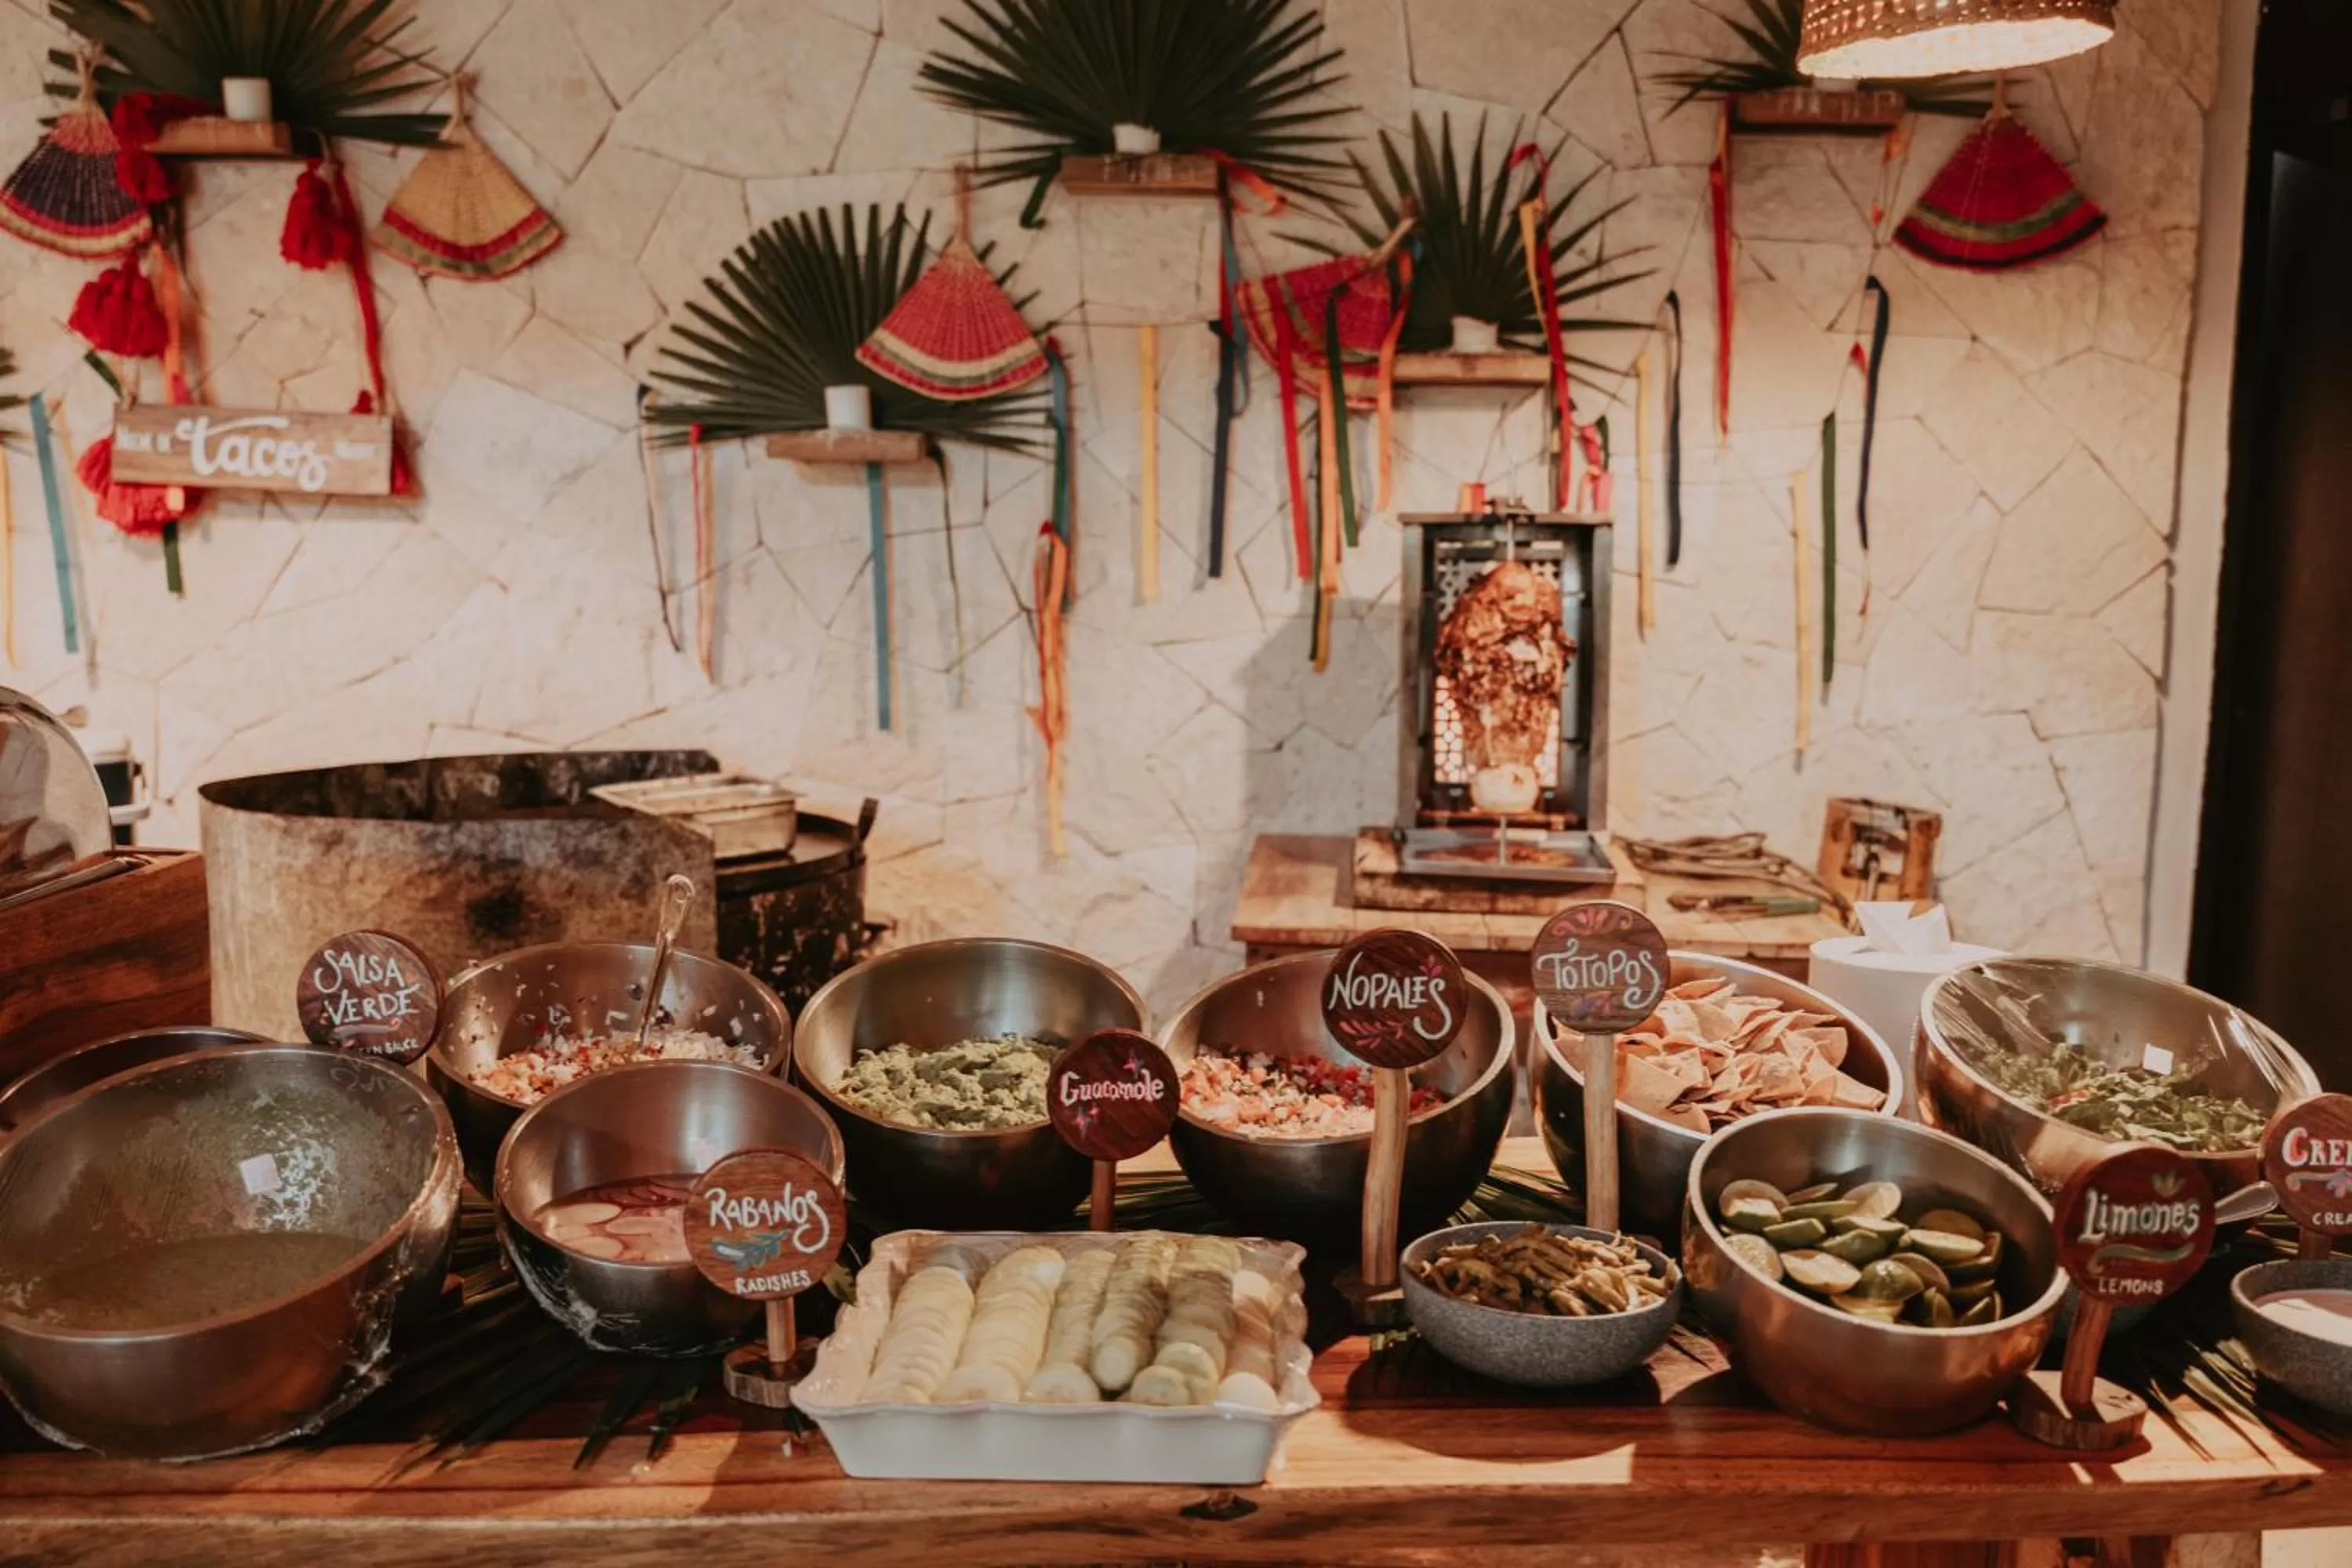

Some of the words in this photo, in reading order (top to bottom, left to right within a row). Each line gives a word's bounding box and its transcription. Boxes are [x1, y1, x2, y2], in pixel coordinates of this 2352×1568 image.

[314, 949, 405, 993] SALSA
[323, 983, 422, 1025] VERDE
[1327, 951, 1453, 1041] NOPALES
[1060, 1068, 1165, 1107] Guacamole
[704, 1181, 830, 1254] RABANOS
[2078, 1188, 2201, 1243] Limones
[734, 1269, 812, 1294] RADISHES
[2097, 1276, 2165, 1296] LEMONS
